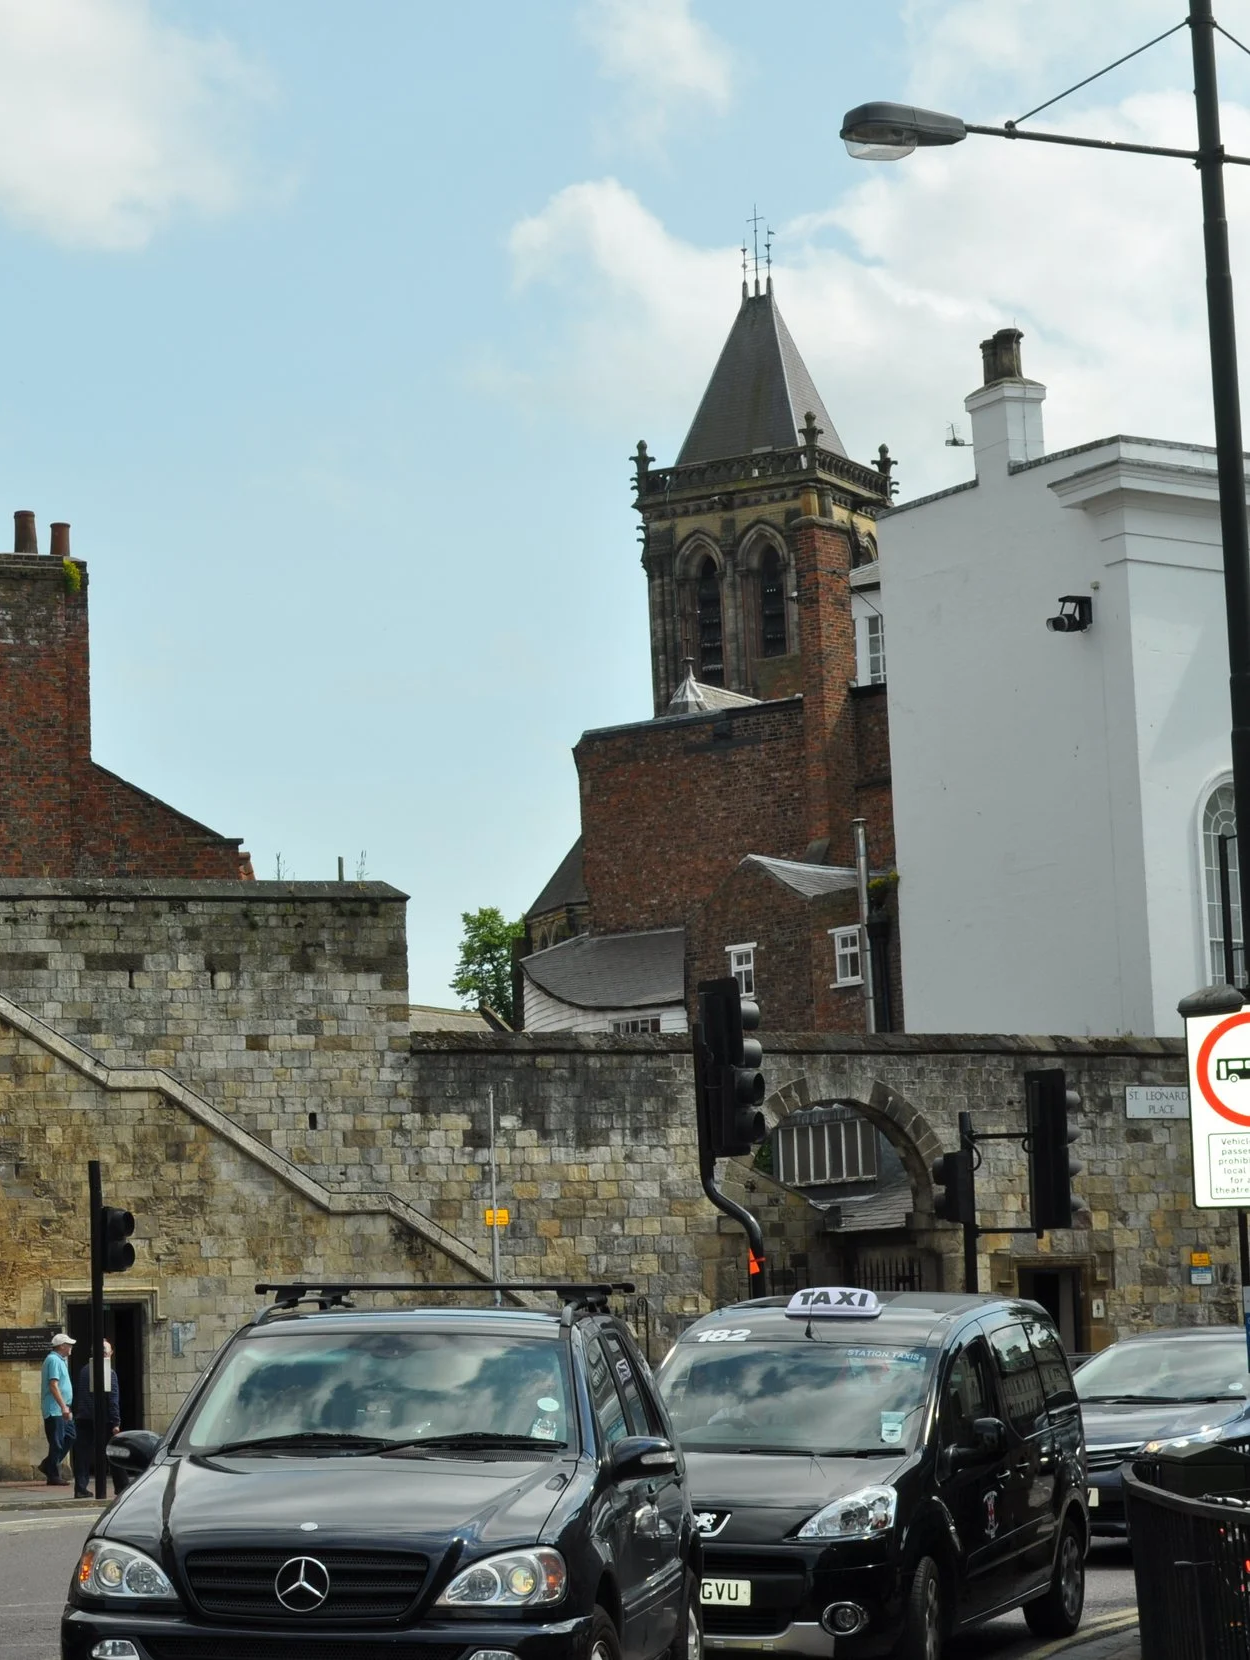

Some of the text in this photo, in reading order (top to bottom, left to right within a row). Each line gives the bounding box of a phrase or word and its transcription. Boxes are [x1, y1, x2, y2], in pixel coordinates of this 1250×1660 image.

[1145, 1090, 1188, 1101] LEONARD
[1148, 1104, 1175, 1114] PLACE
[1218, 1157, 1250, 1165] prohibi
[1223, 1166, 1246, 1175] local
[1230, 1176, 1243, 1184] for
[799, 1291, 869, 1307] TAXI
[696, 1328, 751, 1343] 182
[846, 1349, 920, 1361] STATION TAXIS
[702, 1582, 739, 1601] GVU
